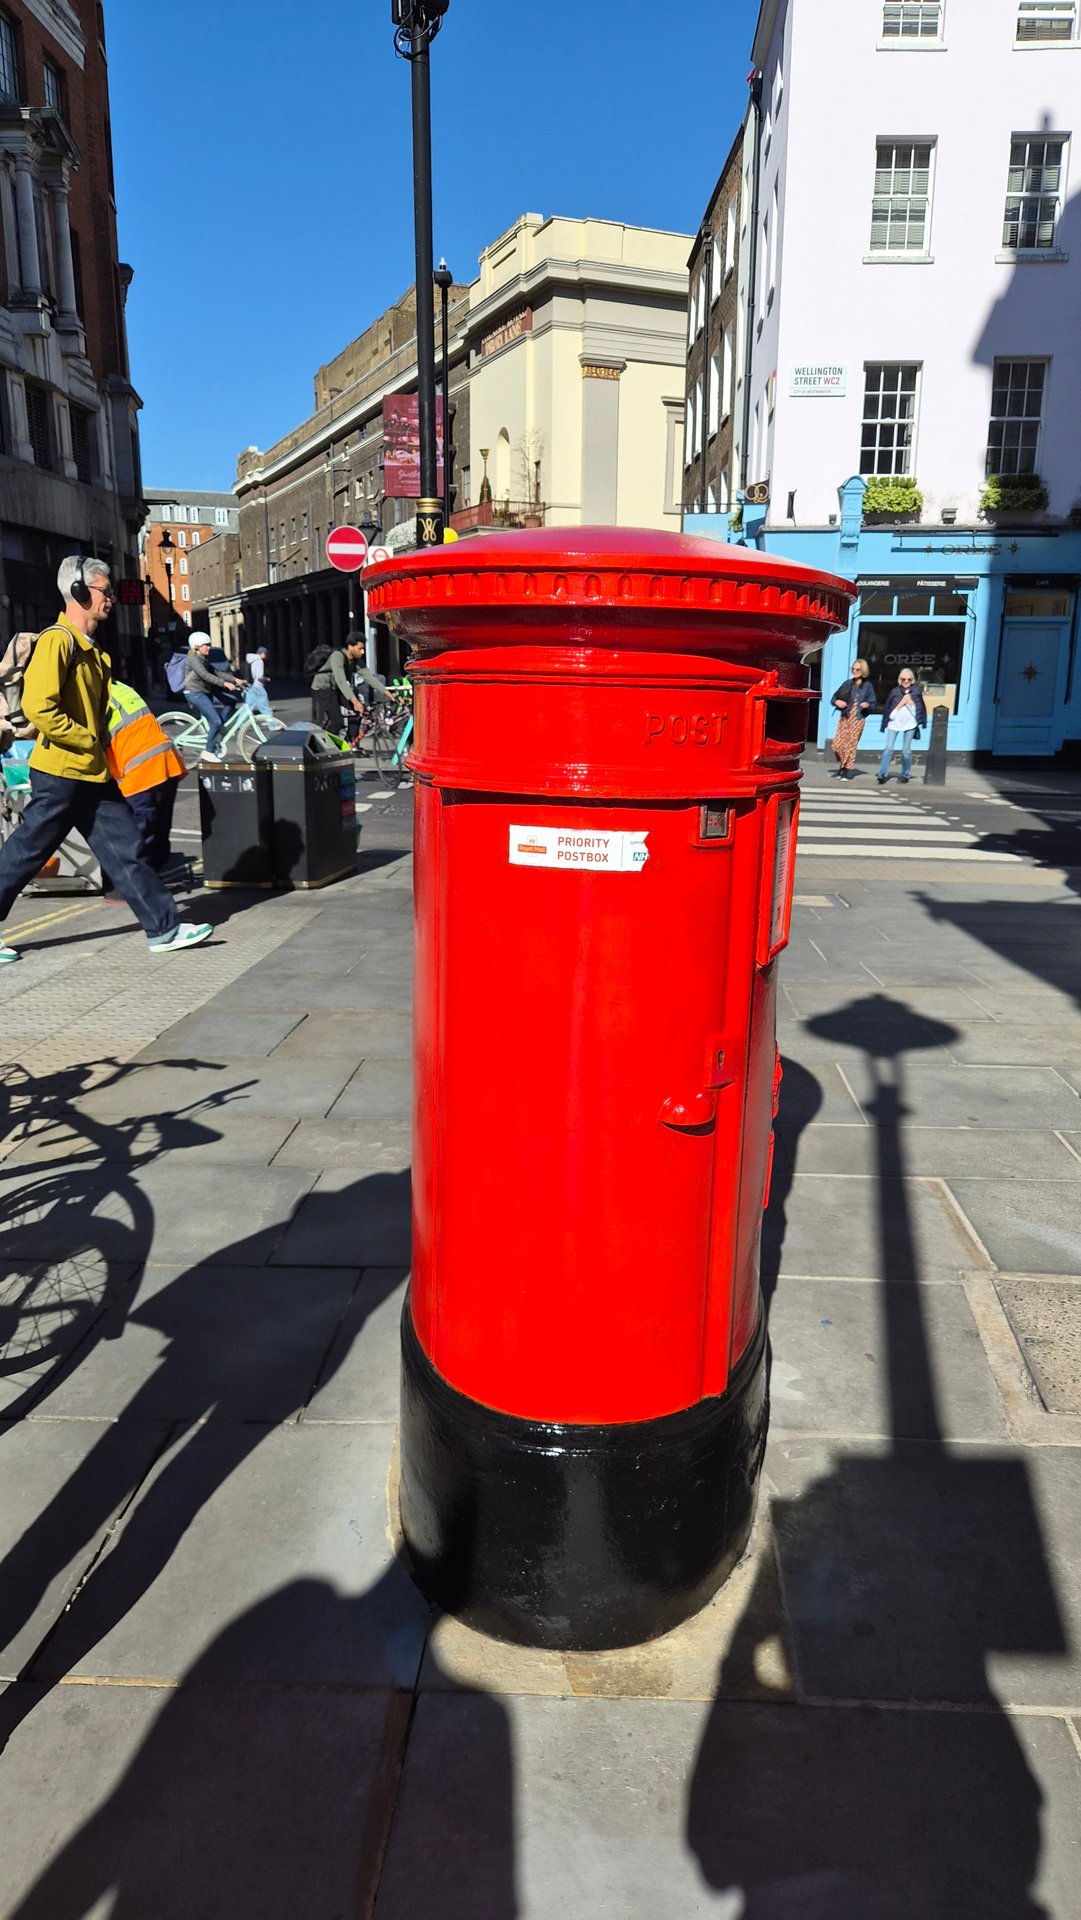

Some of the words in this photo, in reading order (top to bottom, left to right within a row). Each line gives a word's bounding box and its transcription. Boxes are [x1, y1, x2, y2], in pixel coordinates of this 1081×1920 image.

[794, 367, 843, 376] WELLINGTON
[794, 376, 822, 385] STREET
[823, 376, 841, 385] WC2
[642, 711, 728, 747] POST
[557, 836, 610, 848] PRIORITY
[557, 851, 609, 863] POSTBOX
